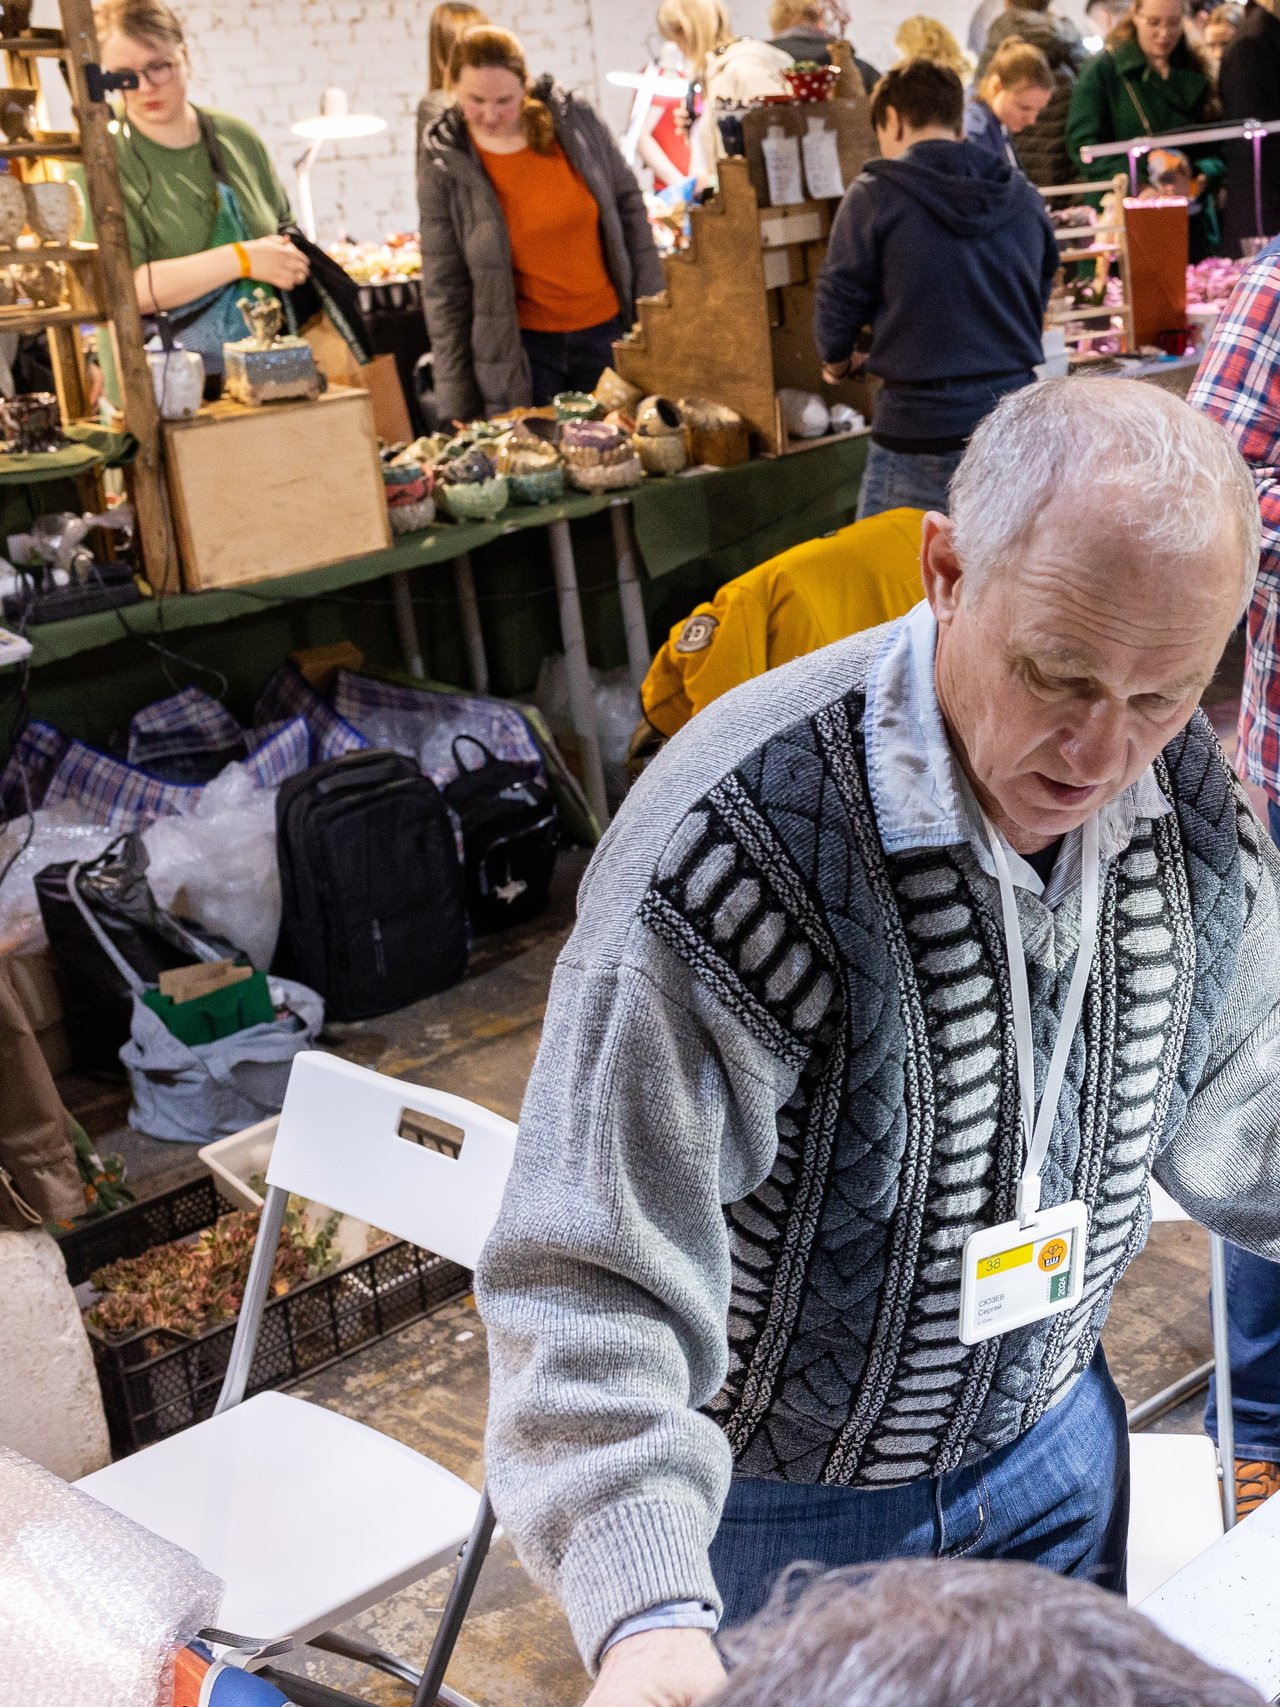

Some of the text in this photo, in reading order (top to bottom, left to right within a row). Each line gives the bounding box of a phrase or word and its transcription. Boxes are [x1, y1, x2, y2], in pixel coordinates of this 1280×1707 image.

[986, 1258, 1001, 1272] 38
[1057, 1276, 1066, 1297] 2024
[978, 1293, 1005, 1307] СЮЗЕВ
[978, 1303, 1002, 1316] Сергей
